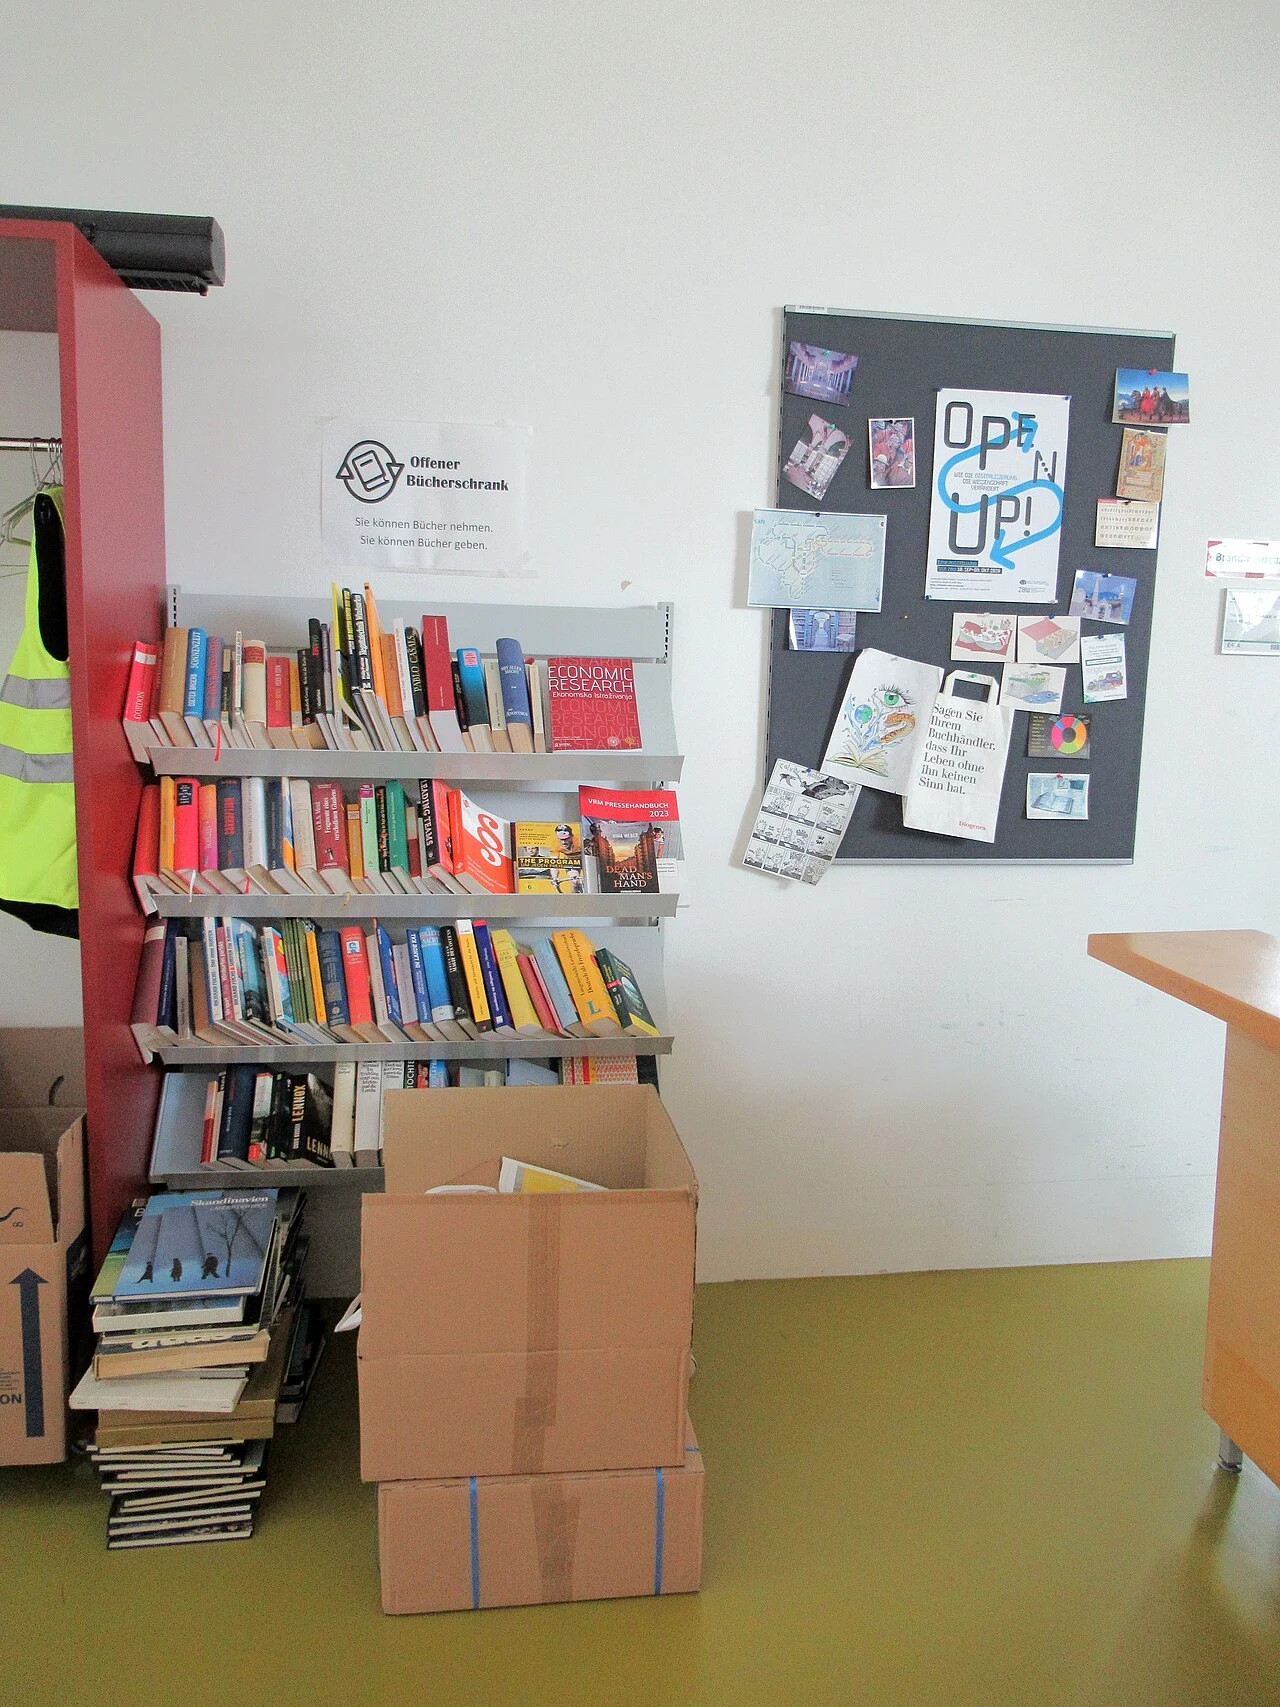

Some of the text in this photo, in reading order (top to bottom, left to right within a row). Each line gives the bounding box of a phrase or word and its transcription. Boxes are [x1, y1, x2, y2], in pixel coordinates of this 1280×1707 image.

[410, 456, 460, 470] Offener
[406, 475, 509, 491] Bücherschrank
[355, 517, 493, 533] Sie können Bücher nehmen.
[948, 492, 1032, 555] UP!
[360, 535, 488, 551] Sie können Bücher geben.
[408, 635, 423, 692] PABLO CASALS
[548, 665, 633, 681] ECONOMIC
[549, 679, 633, 693] RESEARCH
[553, 691, 592, 699] Ekonomska
[134, 691, 145, 719] GORDON
[551, 699, 636, 713] ECONOMIC
[933, 703, 983, 723] Sagen Sie
[552, 713, 637, 726] RESEARCH
[930, 715, 961, 732] Ihrem
[925, 740, 968, 758] dass Ihr
[924, 752, 985, 774] Leben ohne
[921, 764, 976, 785] ihn keinen
[919, 777, 966, 795] Sinn hat.
[588, 798, 669, 810] VRM PRESSEHANDBUCH
[424, 817, 433, 846] TEAMS
[959, 820, 987, 831] Diogenes
[606, 865, 637, 874] DEAD
[619, 872, 653, 880] MAN'S
[583, 974, 593, 993] Deutsch
[292, 1084, 306, 1122] LENNOX
[307, 1136, 332, 1159] LENN
[191, 1196, 268, 1206] Skandinavien
